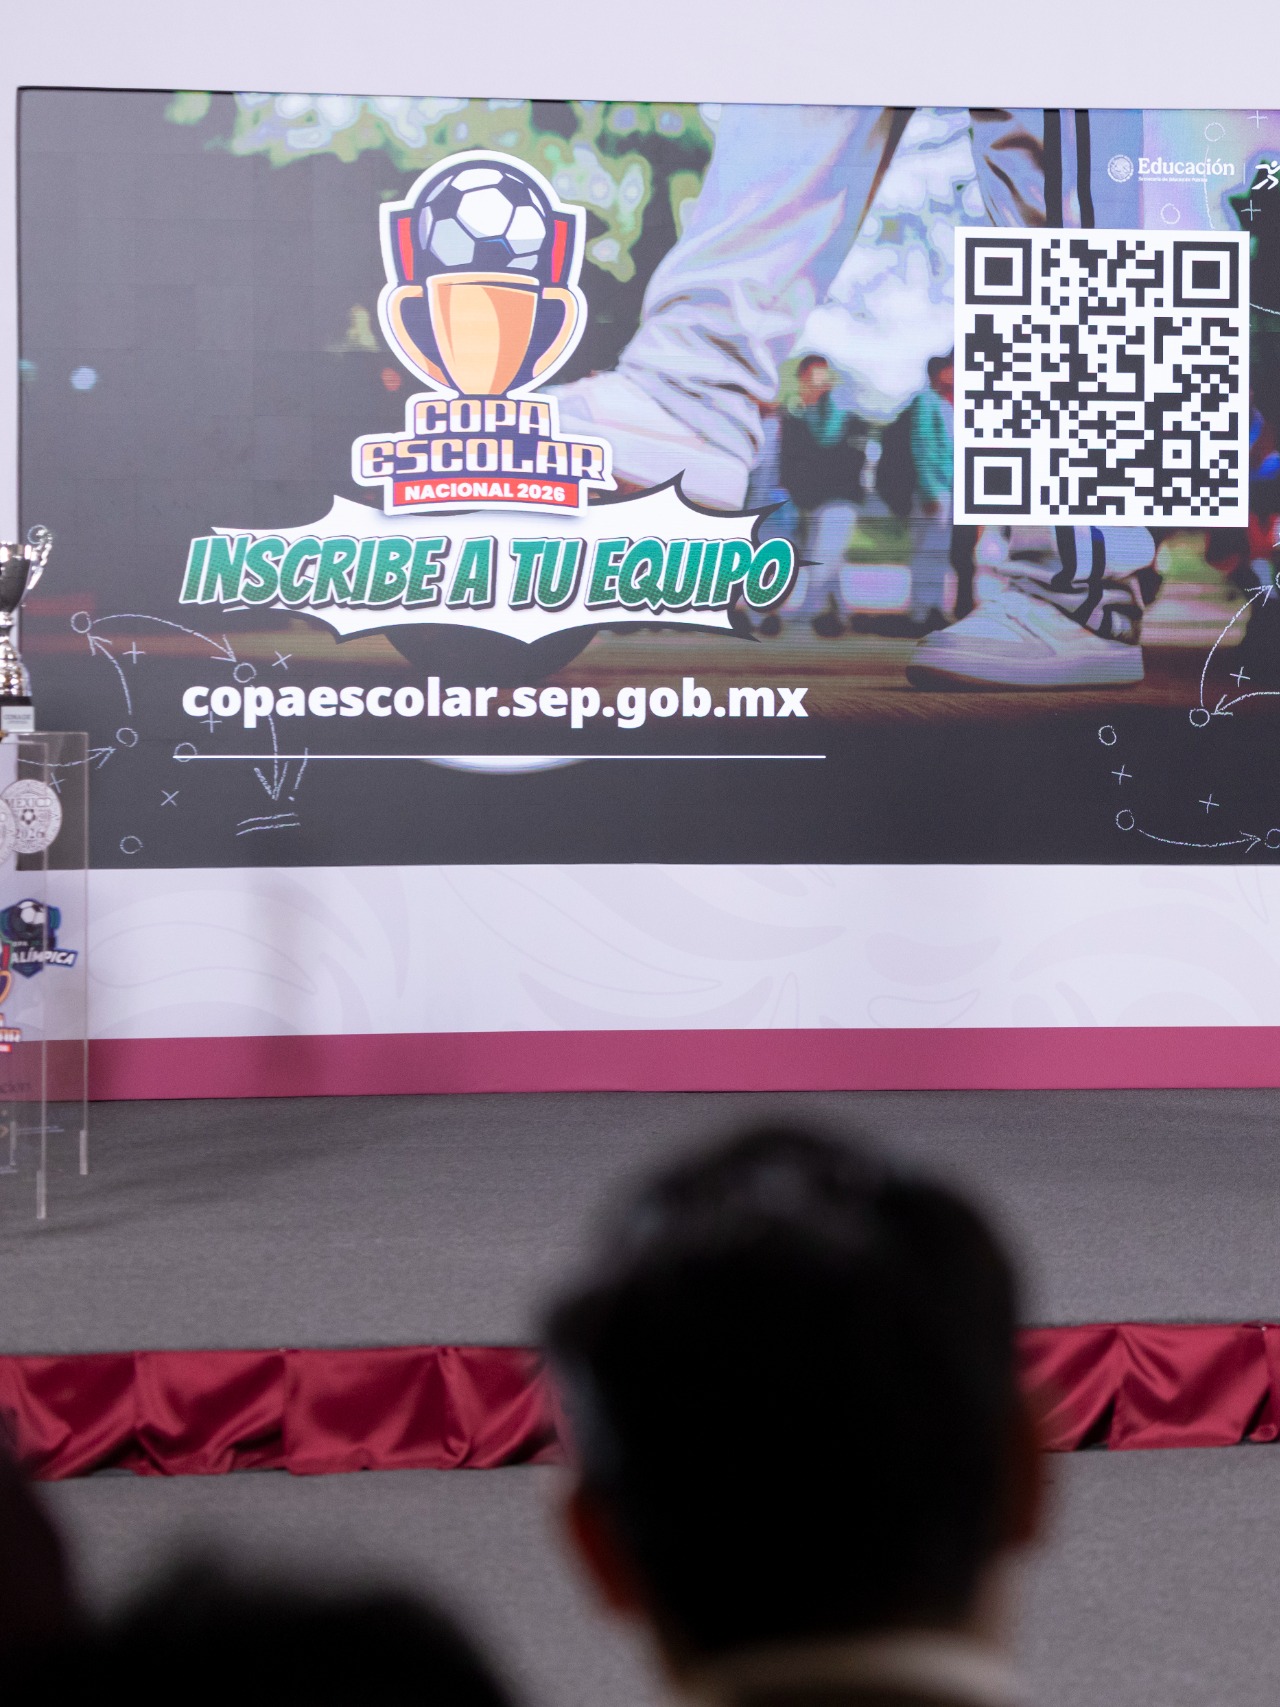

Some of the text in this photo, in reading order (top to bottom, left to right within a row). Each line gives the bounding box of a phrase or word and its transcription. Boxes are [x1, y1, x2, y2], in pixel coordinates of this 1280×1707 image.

[1137, 156, 1235, 176] Educación
[414, 399, 550, 437] COPA
[361, 438, 605, 480] ESCOLAR
[404, 482, 566, 502] NACIONAL 2026
[179, 535, 796, 609] INSCRIBE A TU EQUIPO
[182, 676, 809, 729] copaescolar.sep.gob.mx
